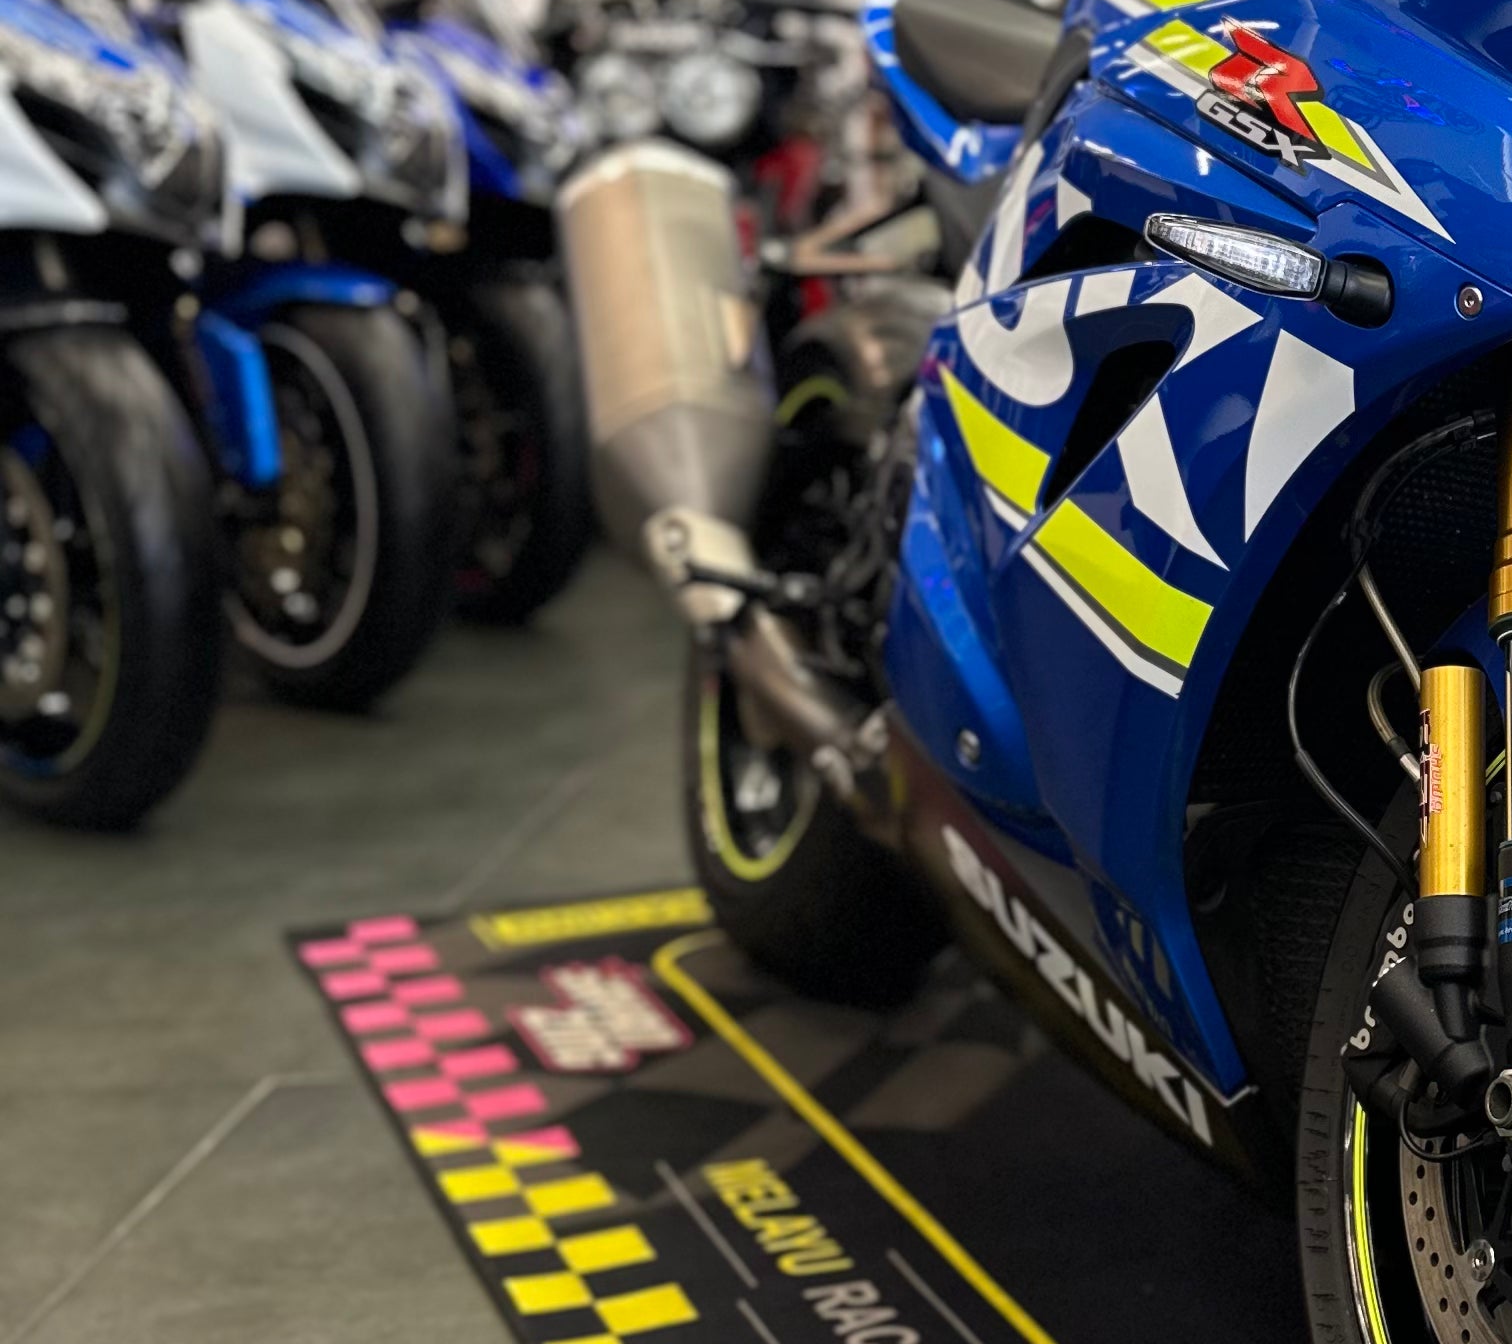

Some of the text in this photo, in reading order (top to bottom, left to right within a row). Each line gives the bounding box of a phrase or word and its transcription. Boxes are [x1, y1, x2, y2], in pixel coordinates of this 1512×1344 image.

[1197, 90, 1317, 167] GSX
[942, 824, 1213, 1146] SUZUKI
[1349, 902, 1414, 1050] brbo
[703, 1158, 854, 1277] MELAYU
